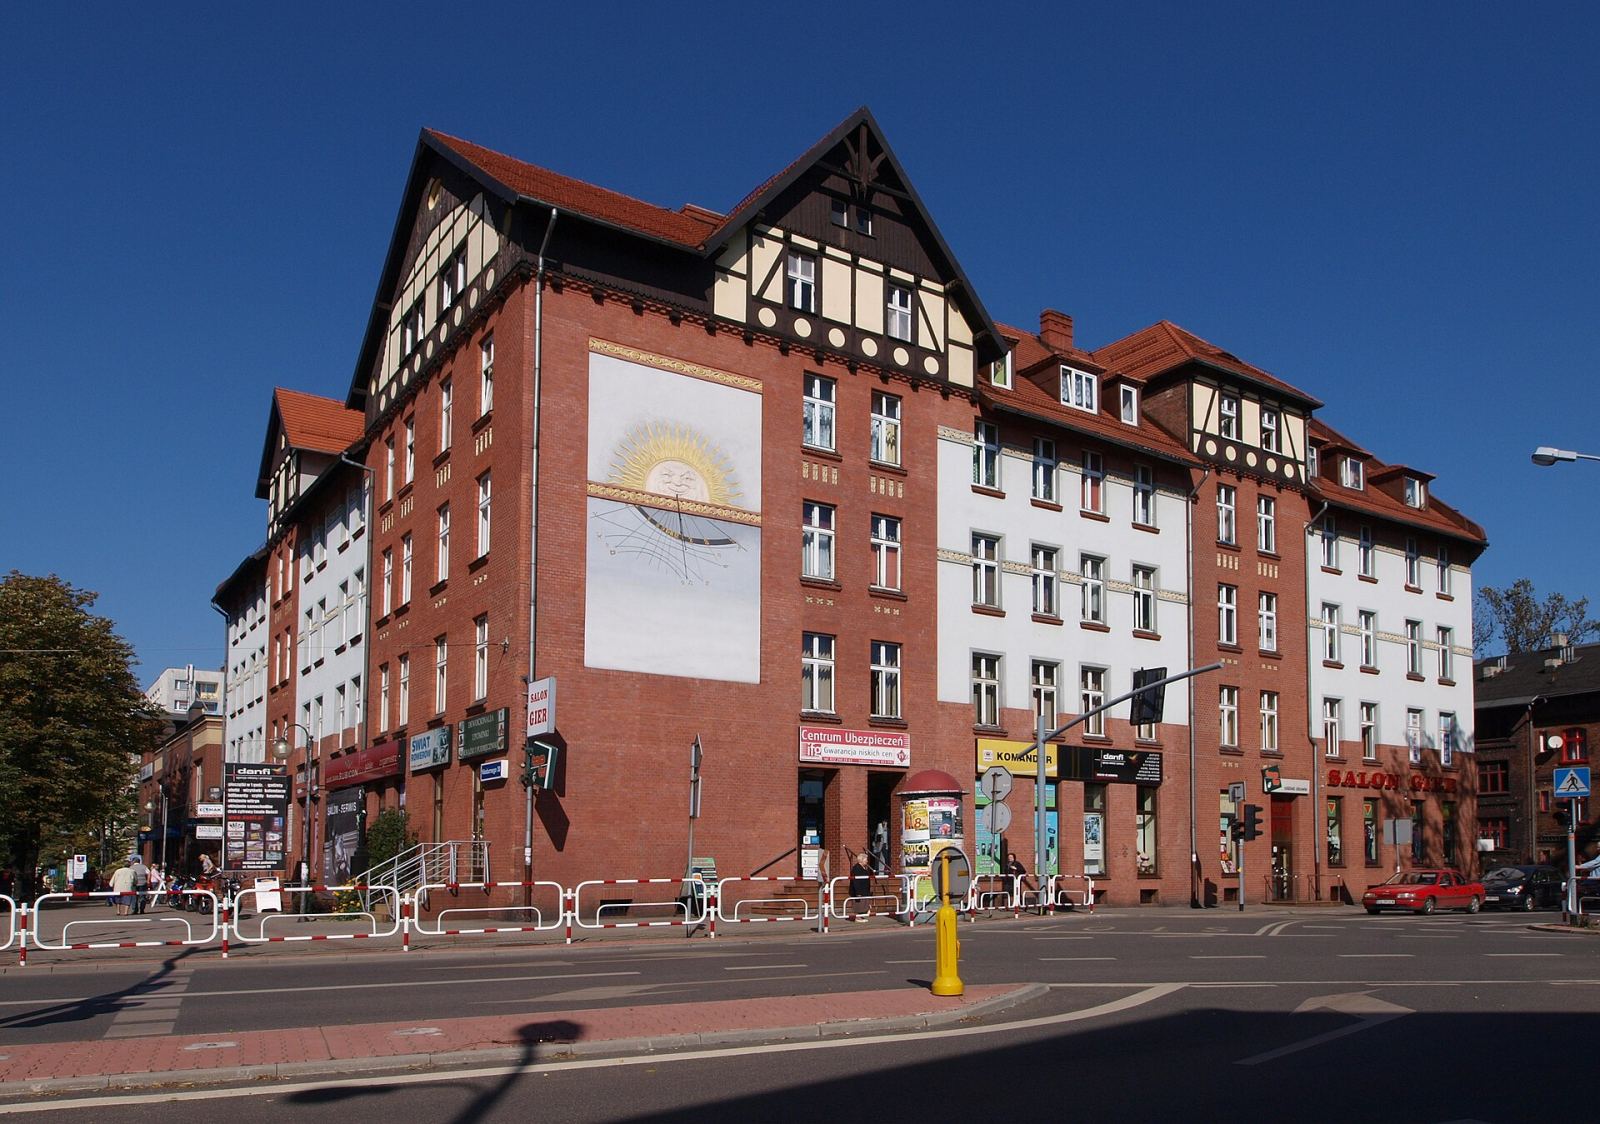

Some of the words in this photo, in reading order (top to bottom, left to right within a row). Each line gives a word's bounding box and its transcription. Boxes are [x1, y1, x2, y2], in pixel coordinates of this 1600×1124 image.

[530, 689, 548, 703] SALON
[529, 707, 548, 726] GIER
[801, 729, 842, 742] Centrum
[844, 732, 903, 747] Ubezpieczeń
[823, 746, 857, 756] Gwarancja
[858, 748, 880, 757] niskich
[996, 751, 1052, 764] KOMANDR
[1103, 753, 1124, 761] danfi
[237, 767, 271, 775] danfi
[1327, 768, 1400, 791] SALON
[1411, 774, 1457, 793] GIER
